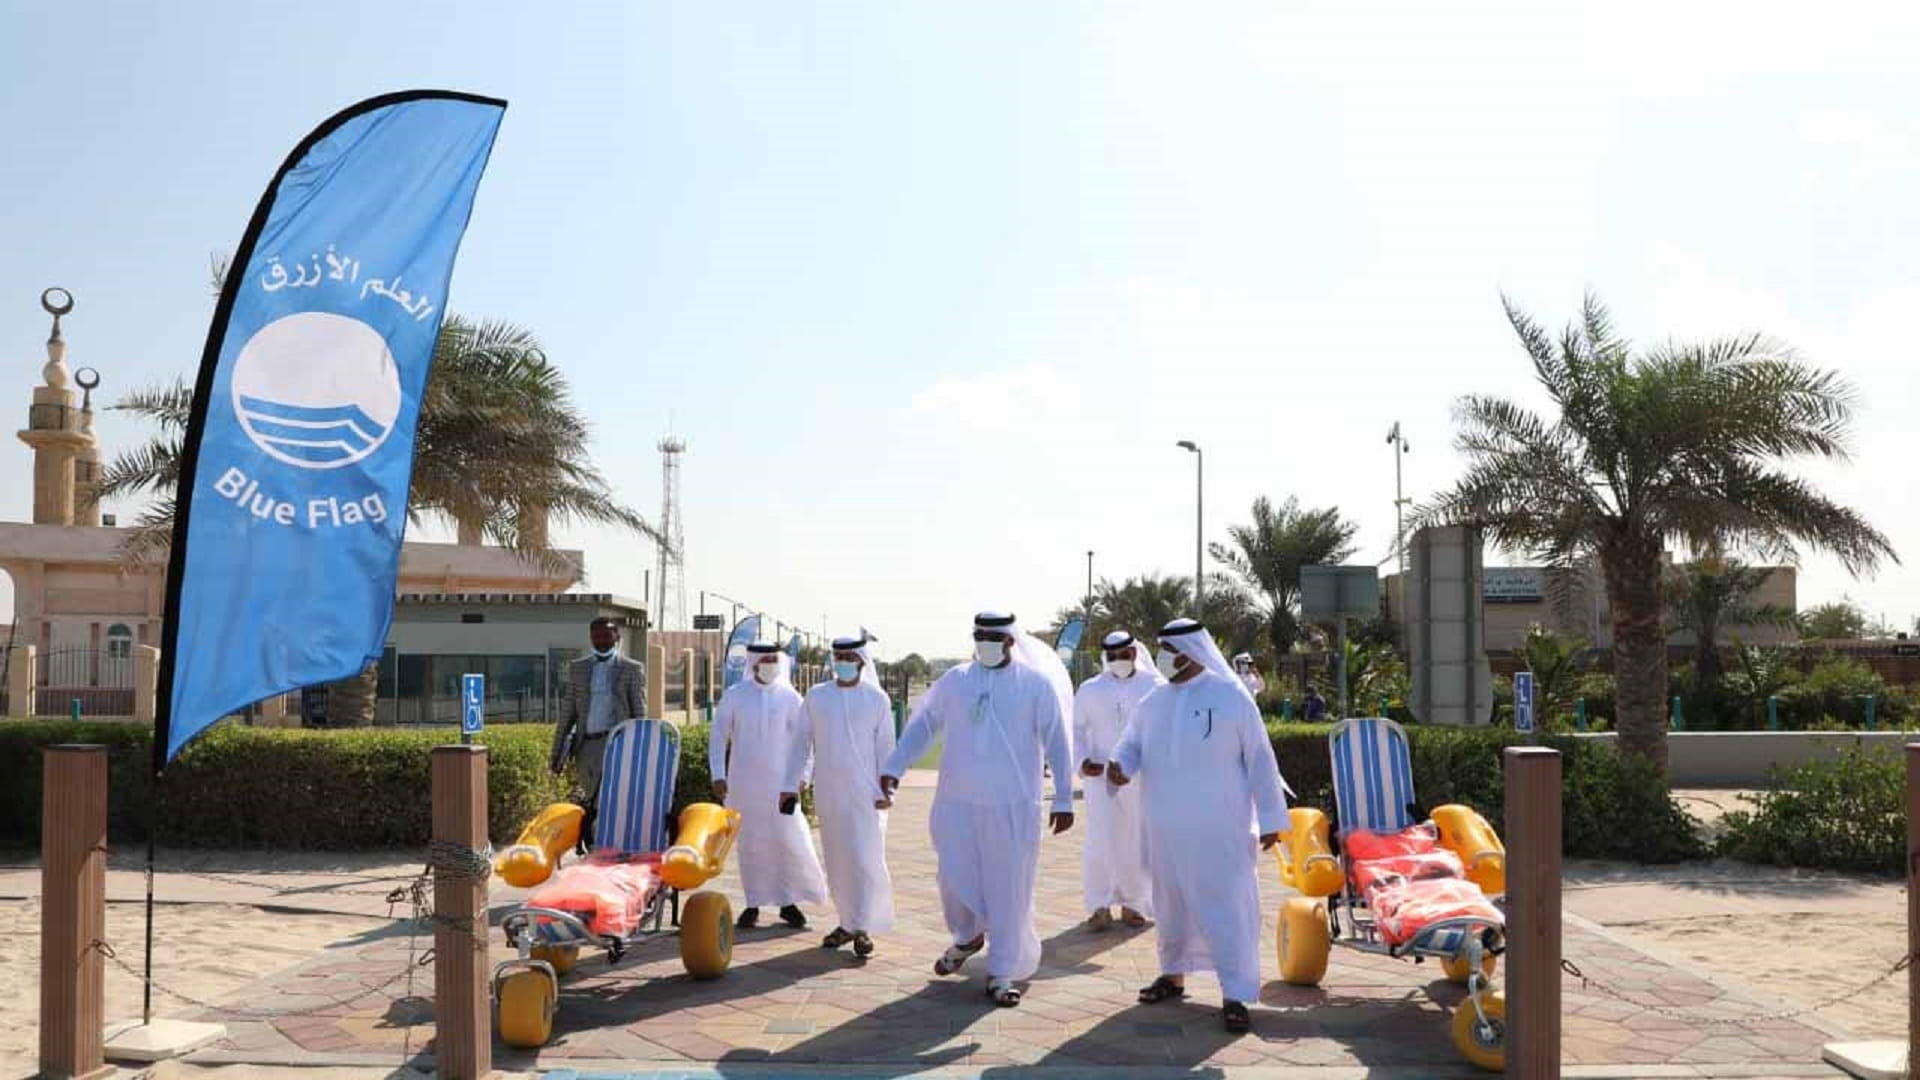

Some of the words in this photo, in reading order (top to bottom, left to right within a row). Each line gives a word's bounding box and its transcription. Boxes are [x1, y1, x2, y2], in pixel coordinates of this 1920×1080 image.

[261, 245, 360, 291] الأزرق
[360, 276, 433, 322] العلم
[214, 466, 296, 525] Blue
[308, 493, 387, 528] Flag
